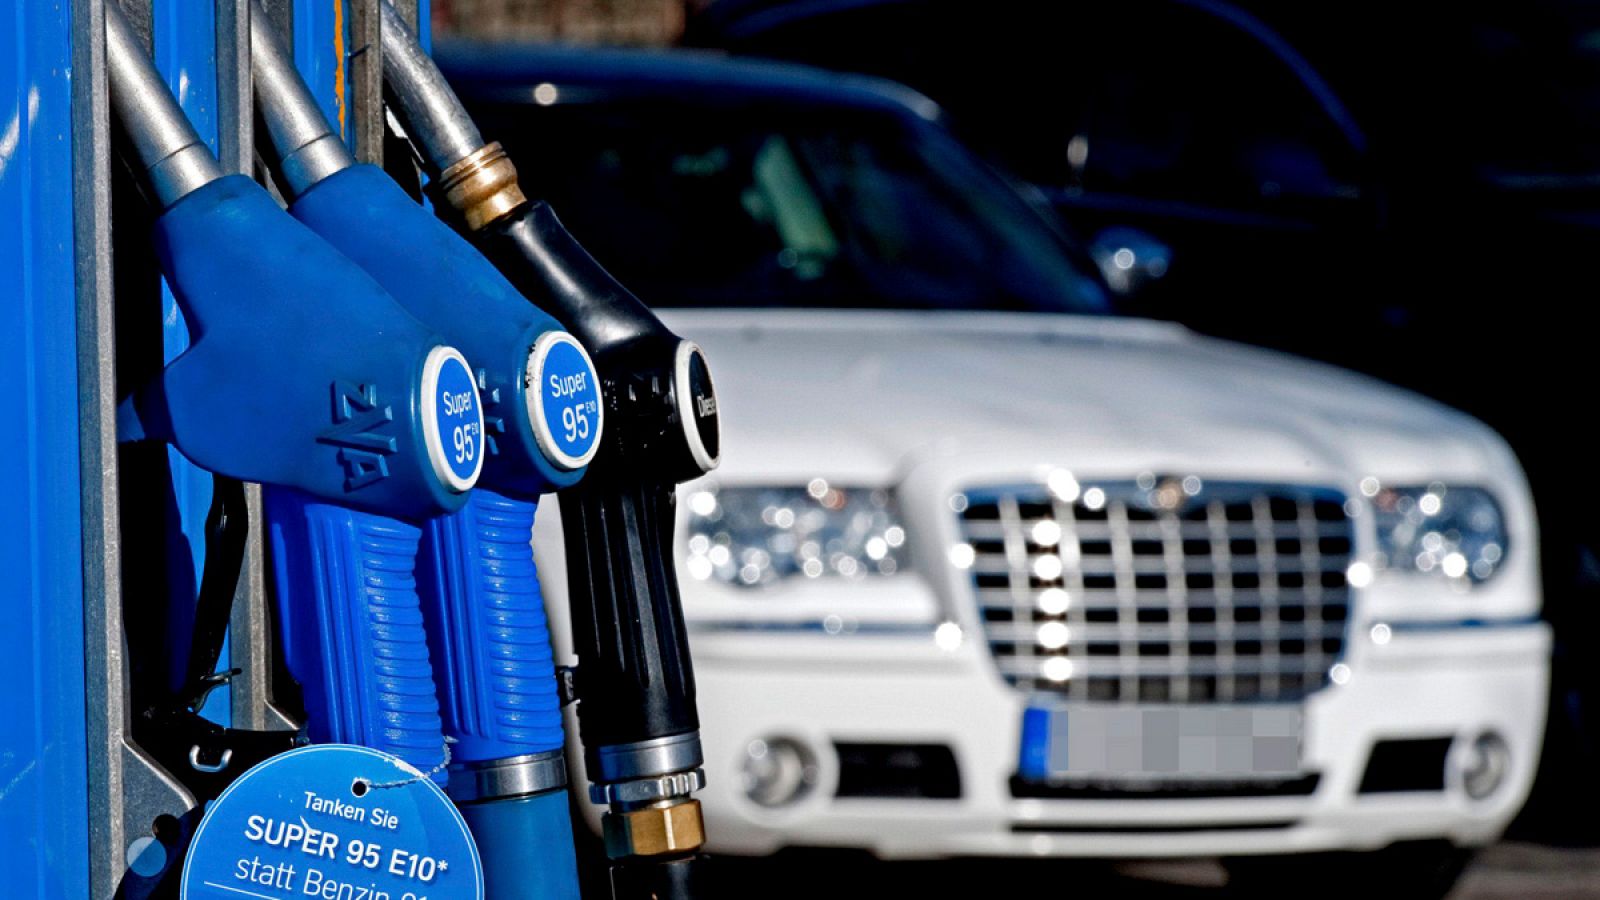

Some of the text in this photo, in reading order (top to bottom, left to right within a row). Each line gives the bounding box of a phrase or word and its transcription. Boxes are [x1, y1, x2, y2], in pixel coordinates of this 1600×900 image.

[443, 391, 472, 418] Super
[550, 372, 587, 399] Super
[562, 403, 590, 443] 95
[453, 423, 475, 464] 95
[303, 791, 400, 830] Tanken Sie
[244, 814, 339, 860] SUPER
[346, 839, 382, 869] 95
[235, 854, 297, 891] statt
